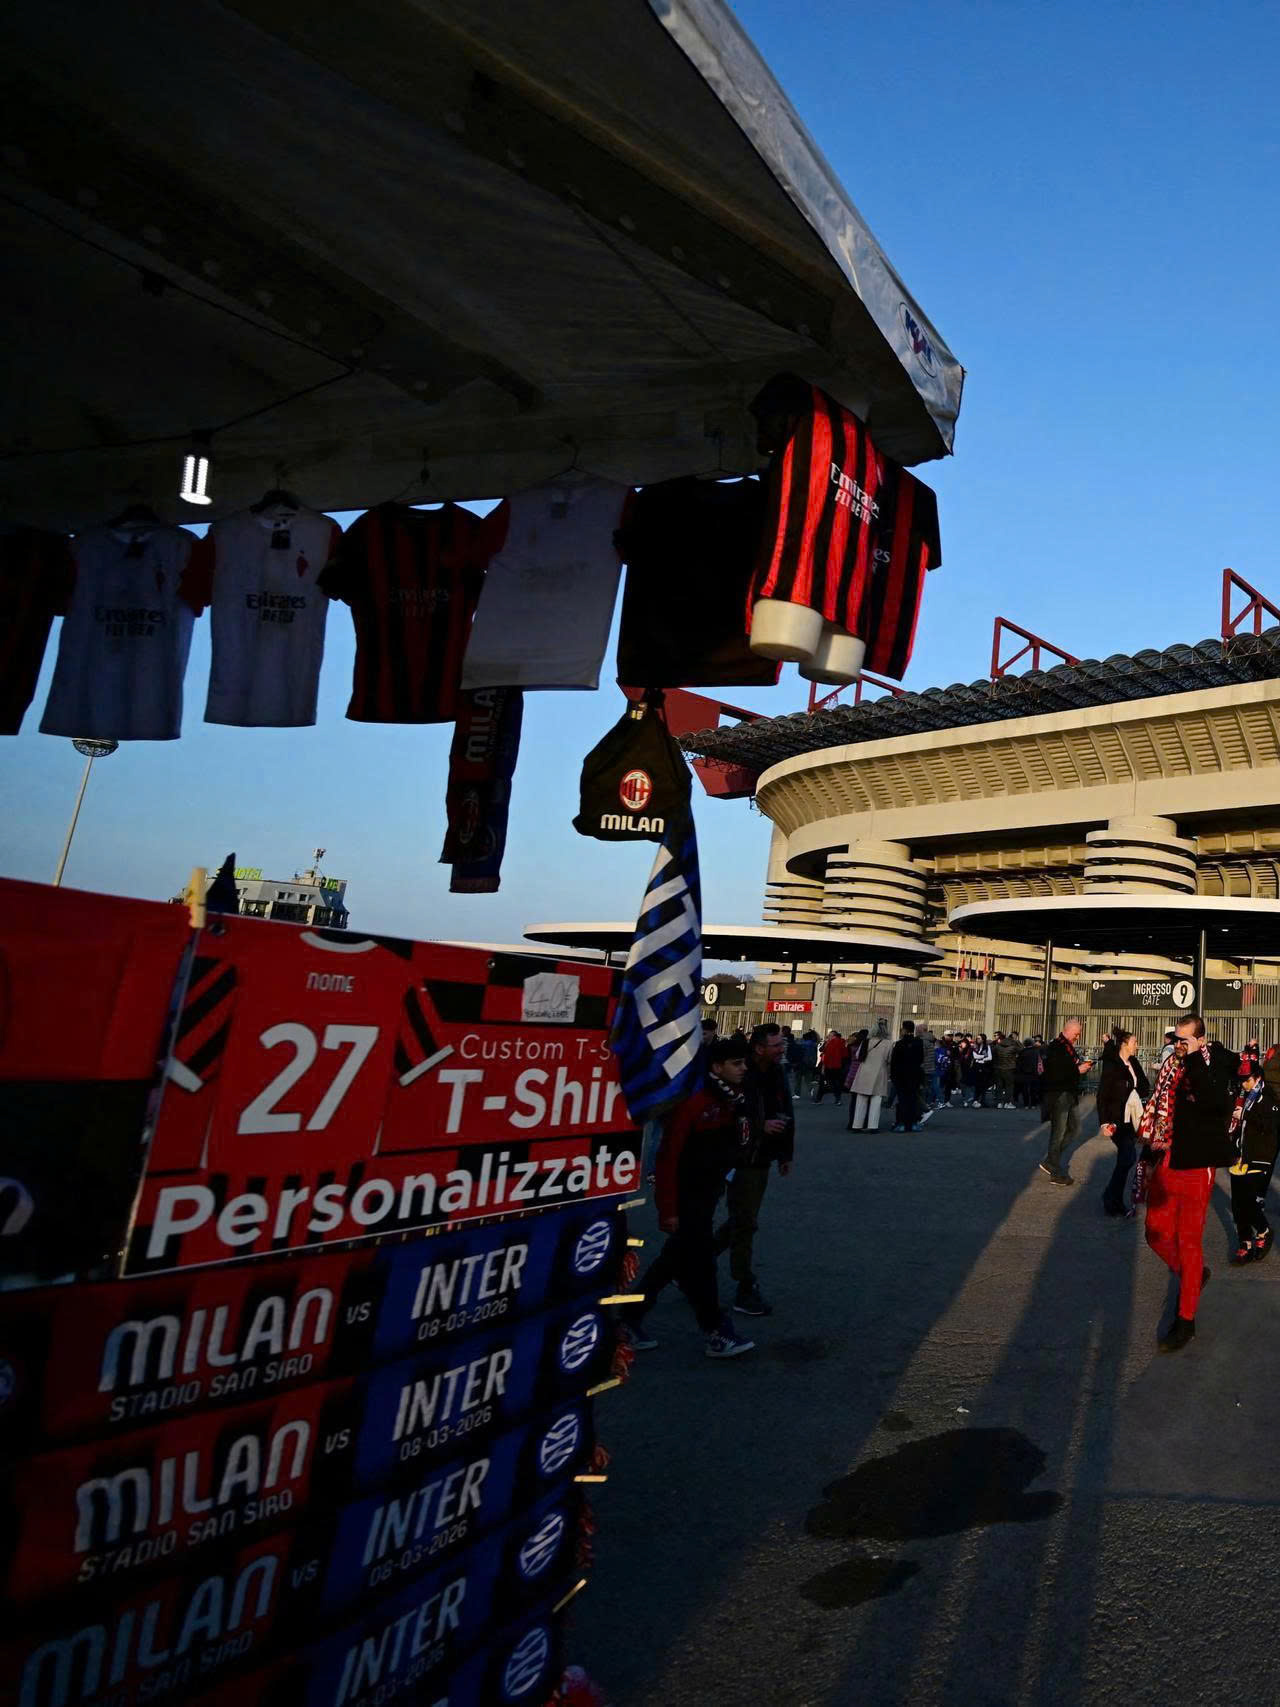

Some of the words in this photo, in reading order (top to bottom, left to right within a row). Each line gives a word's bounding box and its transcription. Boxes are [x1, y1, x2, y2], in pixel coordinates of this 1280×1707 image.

[465, 688, 497, 763] MILA
[600, 813, 665, 833] MILAN
[773, 1002, 805, 1012] Emirates
[1132, 983, 1172, 996] INGRESSO
[1142, 995, 1161, 1006] GATE
[236, 1021, 381, 1136] 27
[459, 1033, 564, 1060] Custom
[575, 1038, 617, 1061] T-S
[437, 1065, 633, 1134] T-Shir
[146, 1144, 638, 1259] Personalizzate
[97, 1287, 334, 1393] MILAN
[410, 1243, 529, 1320] INTER
[416, 1297, 510, 1342] 08-03-2026
[108, 1380, 201, 1424] STADIO
[208, 1364, 258, 1398] SAN
[262, 1353, 314, 1385] SIRO
[73, 1419, 311, 1553] MILAN
[391, 1348, 514, 1442] INTER
[399, 1405, 493, 1462] 08-03-2026
[77, 1530, 178, 1584] STADIO
[186, 1507, 237, 1546] SAN
[242, 1487, 294, 1526] SIRO
[367, 1519, 469, 1588] 08-03-2026
[18, 1553, 281, 1707] MILAN
[361, 1457, 491, 1568] INTER
[334, 1575, 468, 1707] INTER
